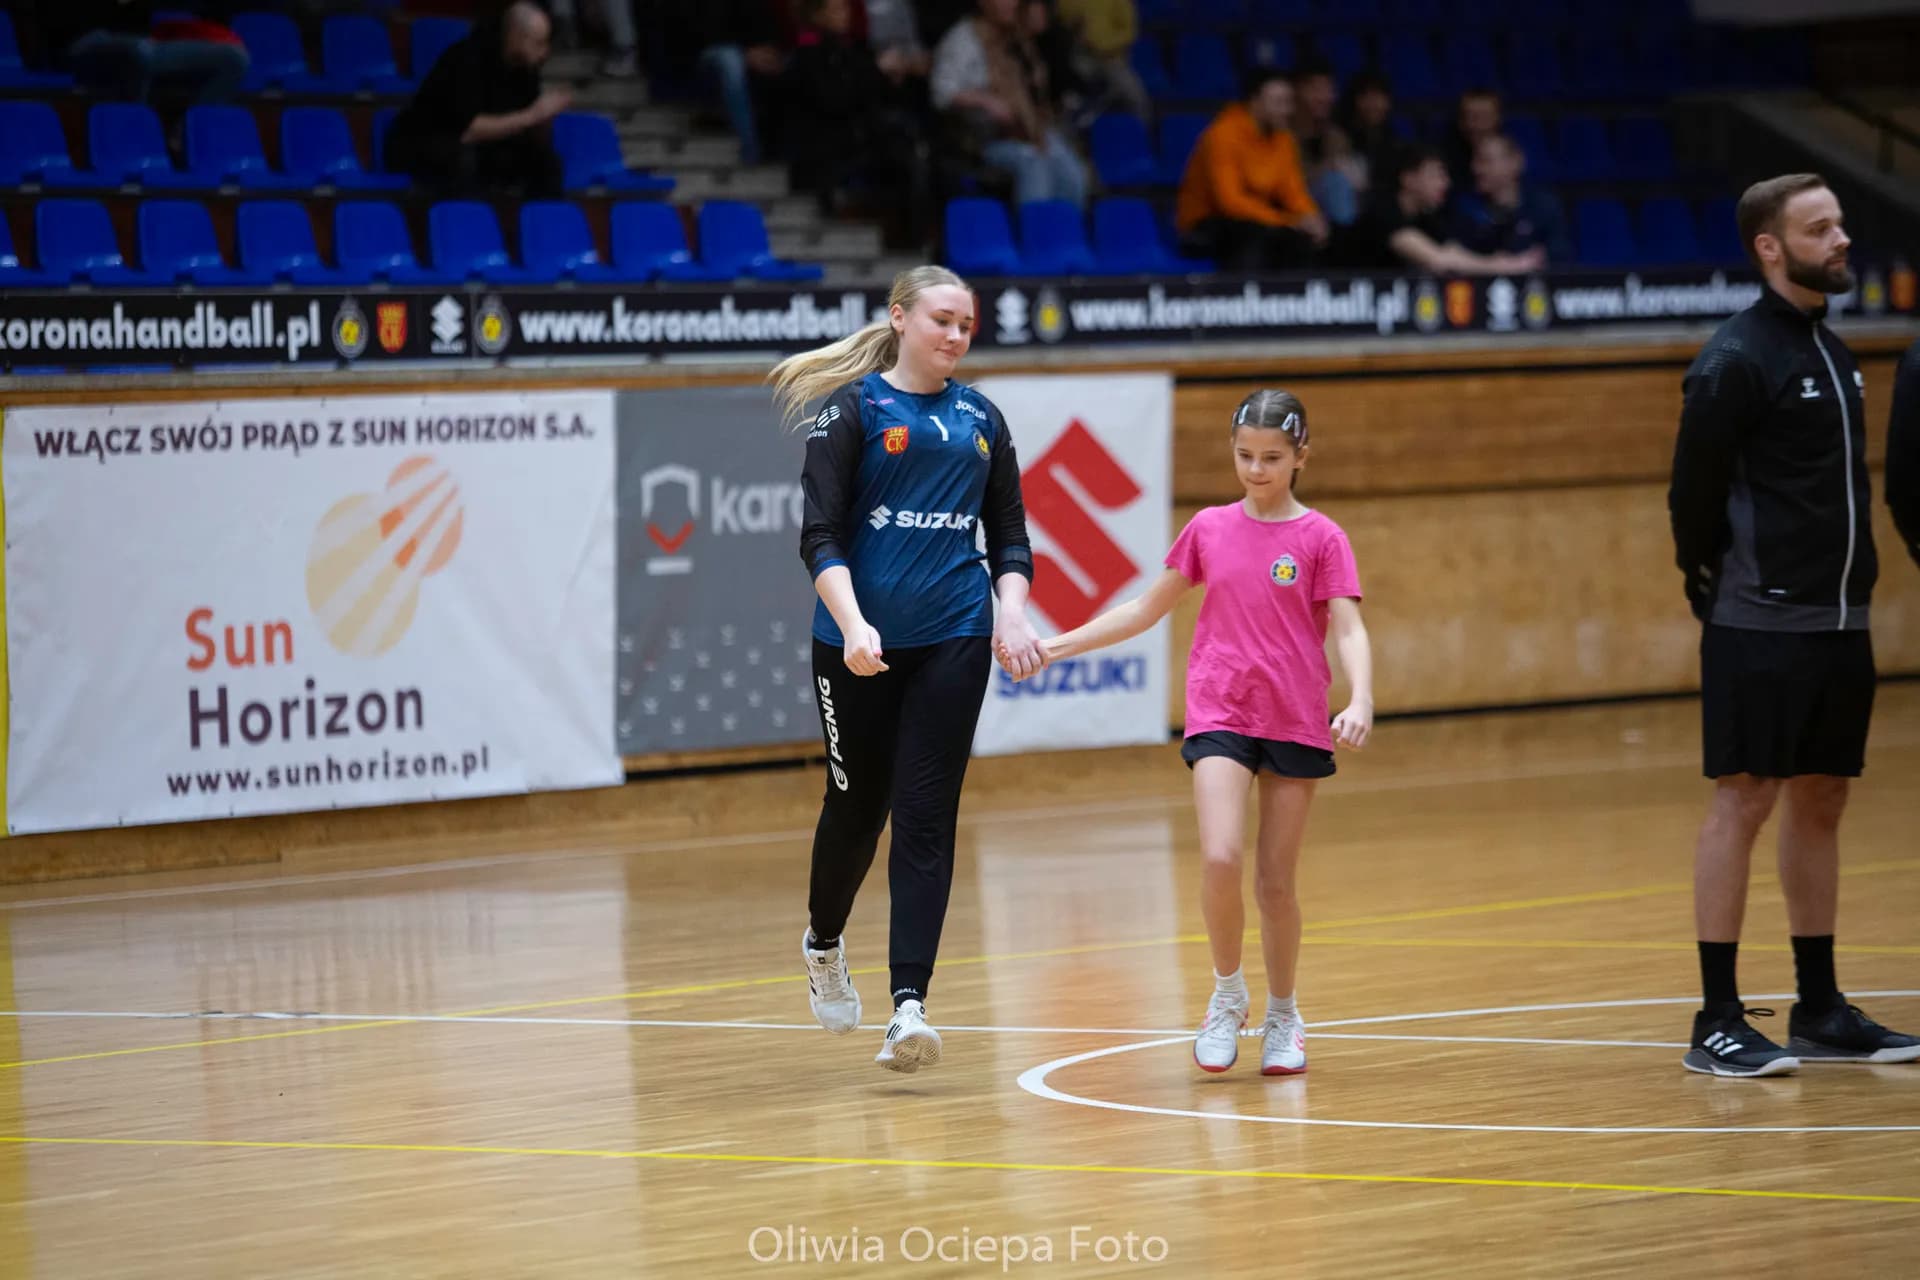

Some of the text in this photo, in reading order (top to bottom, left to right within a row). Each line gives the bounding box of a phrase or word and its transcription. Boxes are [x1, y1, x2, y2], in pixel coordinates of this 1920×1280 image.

[34, 413, 595, 464] WŁĄCZ SWÓJ PRĄD Z SUN HORIZON S.A.
[929, 415, 949, 441] 1
[895, 510, 975, 530] SUZUK
[185, 606, 294, 671] Sun
[188, 677, 425, 750] Horizon
[166, 745, 490, 796] www.sunhorizon.pl
